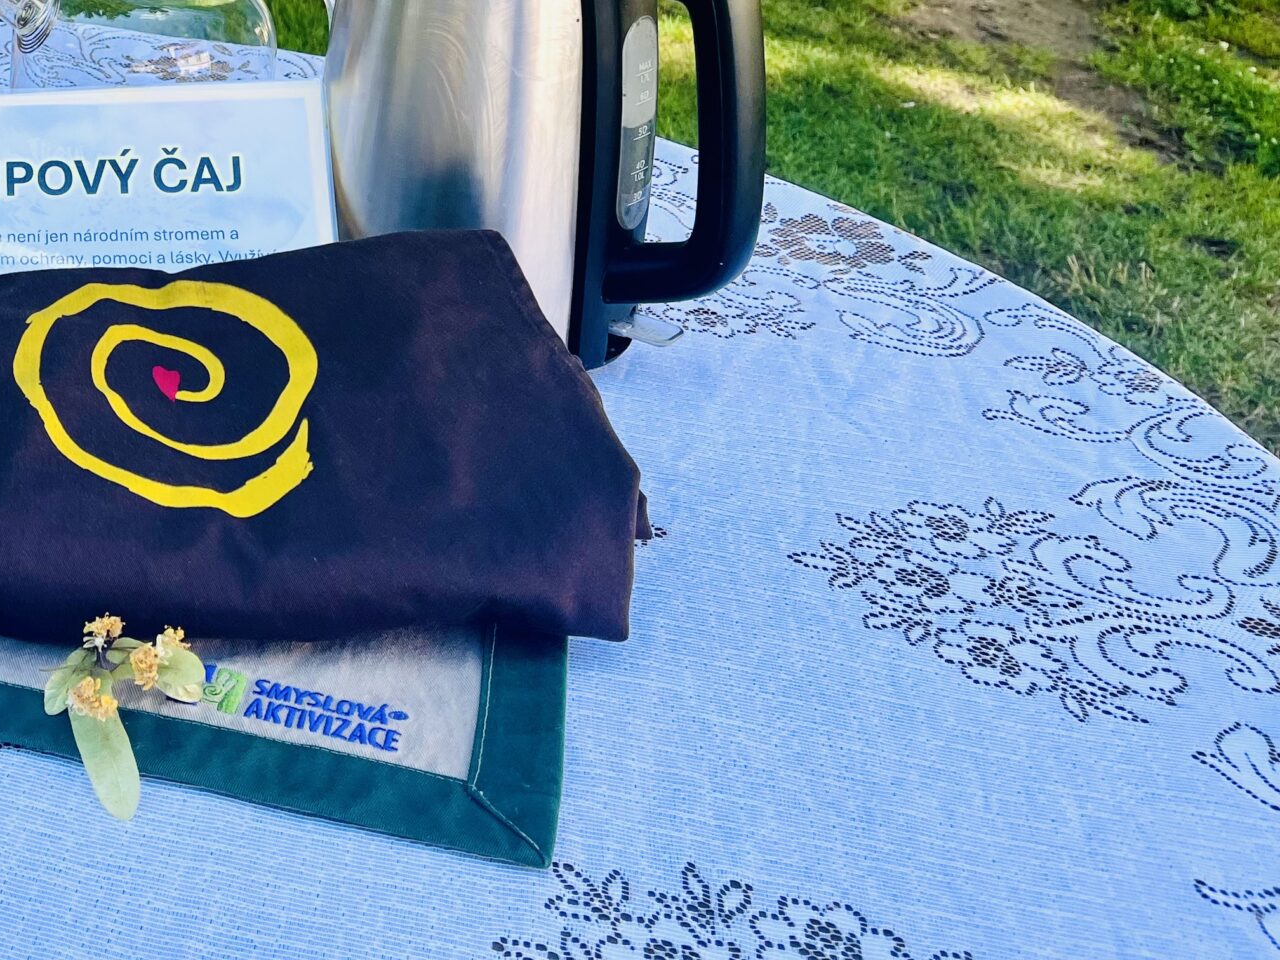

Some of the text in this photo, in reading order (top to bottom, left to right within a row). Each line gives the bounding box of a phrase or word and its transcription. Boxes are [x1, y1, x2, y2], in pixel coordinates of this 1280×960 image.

[153, 147, 242, 193] ČAJ
[7, 230, 41, 243] není
[44, 230, 69, 245] jen
[73, 228, 149, 242] národním
[153, 229, 225, 241] stromem
[229, 232, 239, 240] a
[92, 251, 152, 267] pomoci
[156, 255, 166, 264] a
[170, 250, 215, 265] lásky.
[243, 698, 402, 752] AKTIVIZACE
